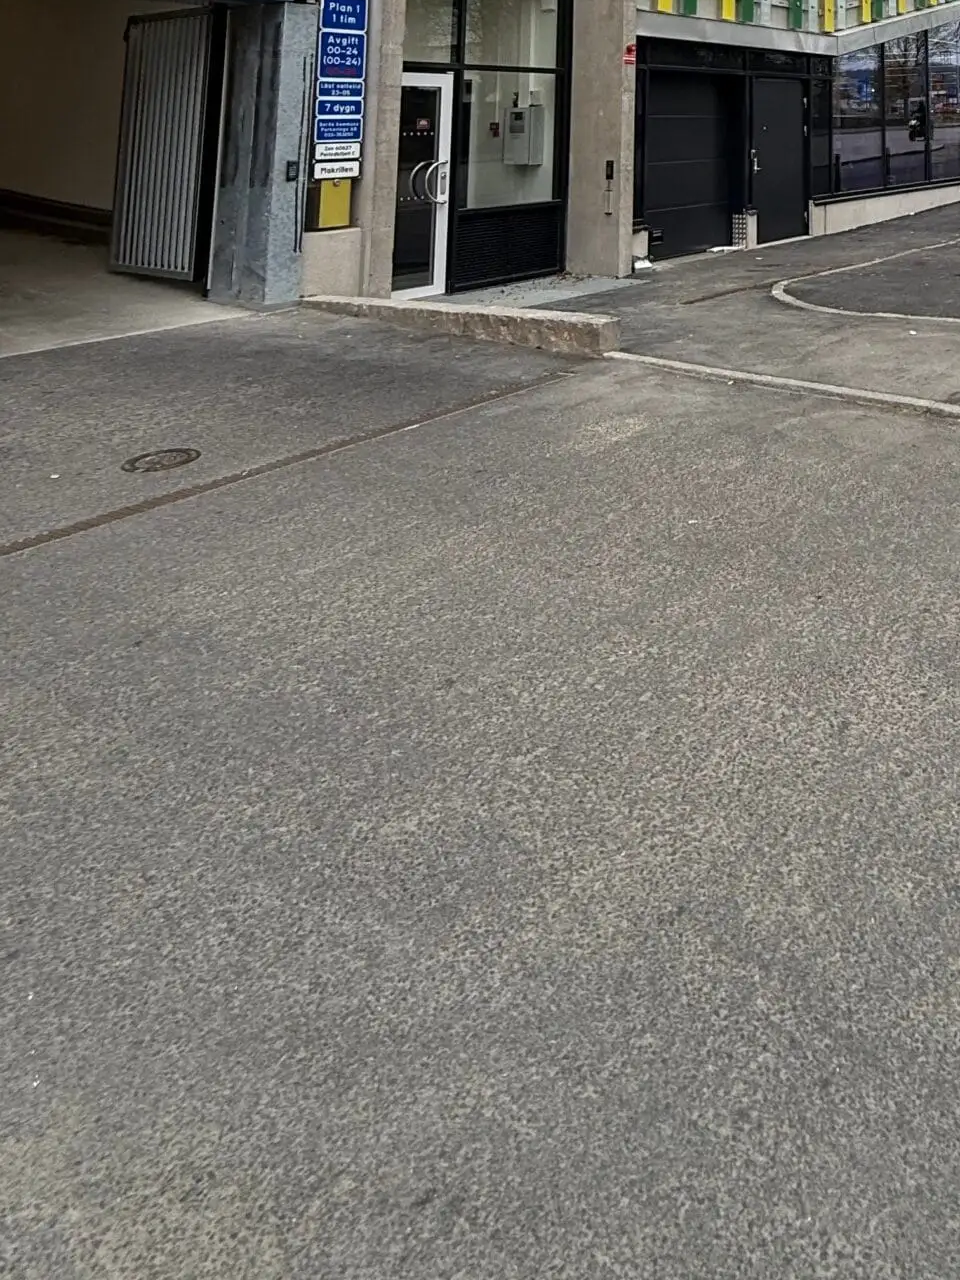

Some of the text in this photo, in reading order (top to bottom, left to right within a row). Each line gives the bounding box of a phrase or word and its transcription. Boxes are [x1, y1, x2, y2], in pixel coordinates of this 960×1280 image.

[329, 2, 361, 14] Plan 1
[332, 13, 356, 24] 1 tim
[328, 35, 359, 46] Avgift
[327, 46, 358, 55] 00-24
[323, 55, 361, 66] (00-24)
[325, 103, 356, 113] 7 dygn
